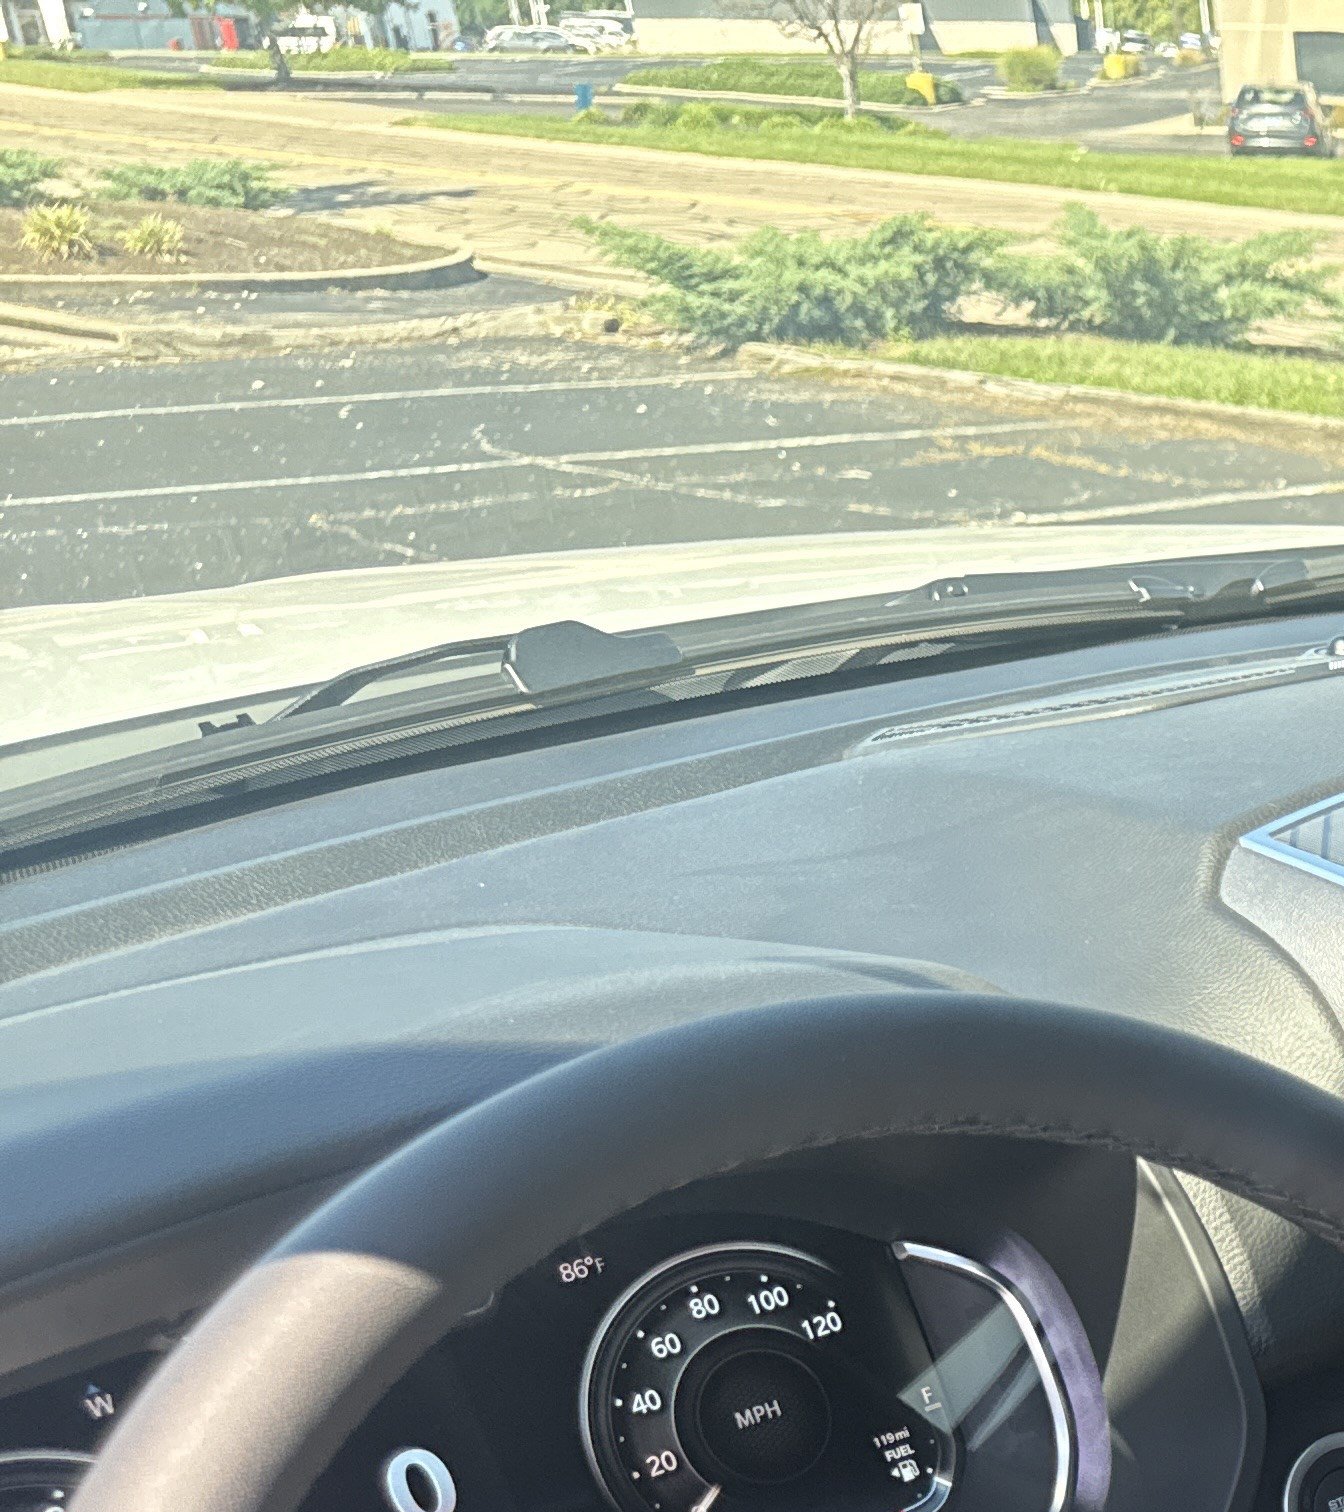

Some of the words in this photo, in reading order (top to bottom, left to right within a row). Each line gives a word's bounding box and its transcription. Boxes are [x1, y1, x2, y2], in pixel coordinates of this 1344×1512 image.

[689, 1293, 721, 1320] 80
[748, 1285, 790, 1315] 100
[801, 1311, 844, 1341] 120
[650, 1332, 682, 1359] 60
[84, 1393, 115, 1418] W
[631, 1388, 662, 1415] 40
[920, 1386, 933, 1405] F
[733, 1399, 783, 1430] MPH
[645, 1450, 678, 1478] 20
[884, 1443, 916, 1463] FUEL
